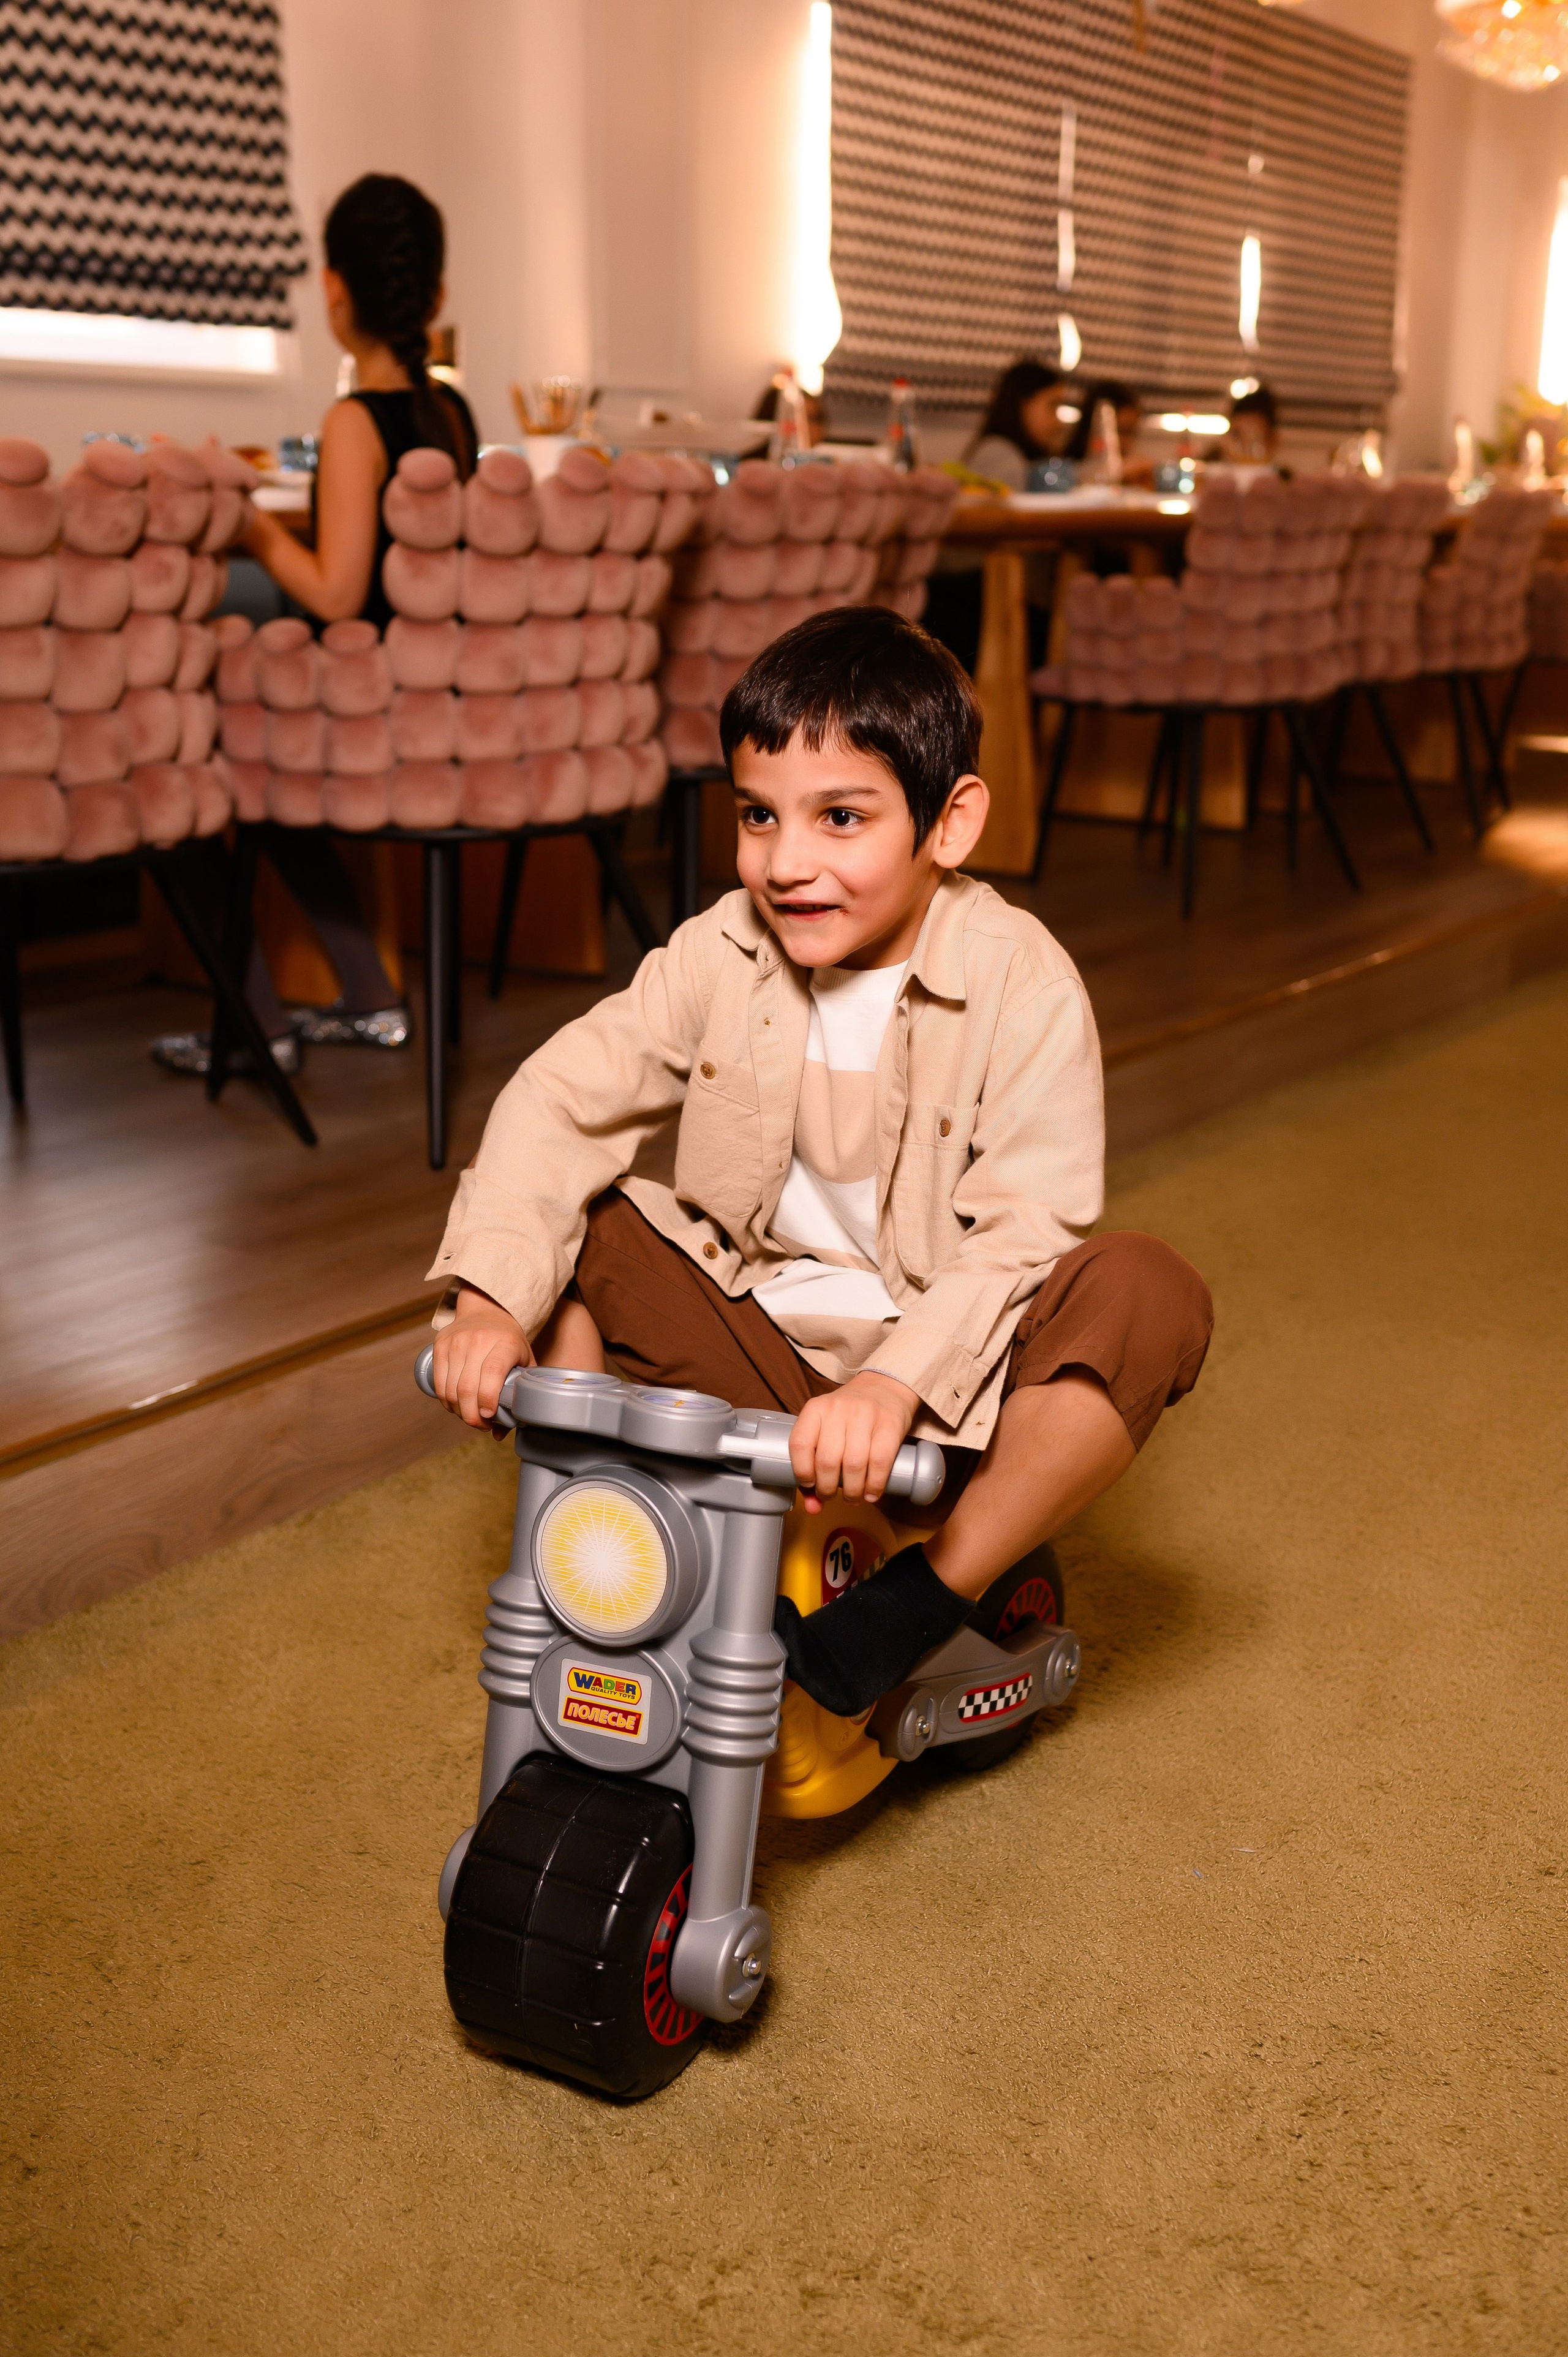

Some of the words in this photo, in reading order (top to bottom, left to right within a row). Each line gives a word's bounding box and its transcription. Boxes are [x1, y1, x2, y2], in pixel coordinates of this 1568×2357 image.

[829, 1541, 852, 1583] 76
[573, 1672, 636, 1695] WADER
[590, 1686, 617, 1695] QUALITY
[567, 1702, 636, 1730] ПОЛЕСЬЕ
